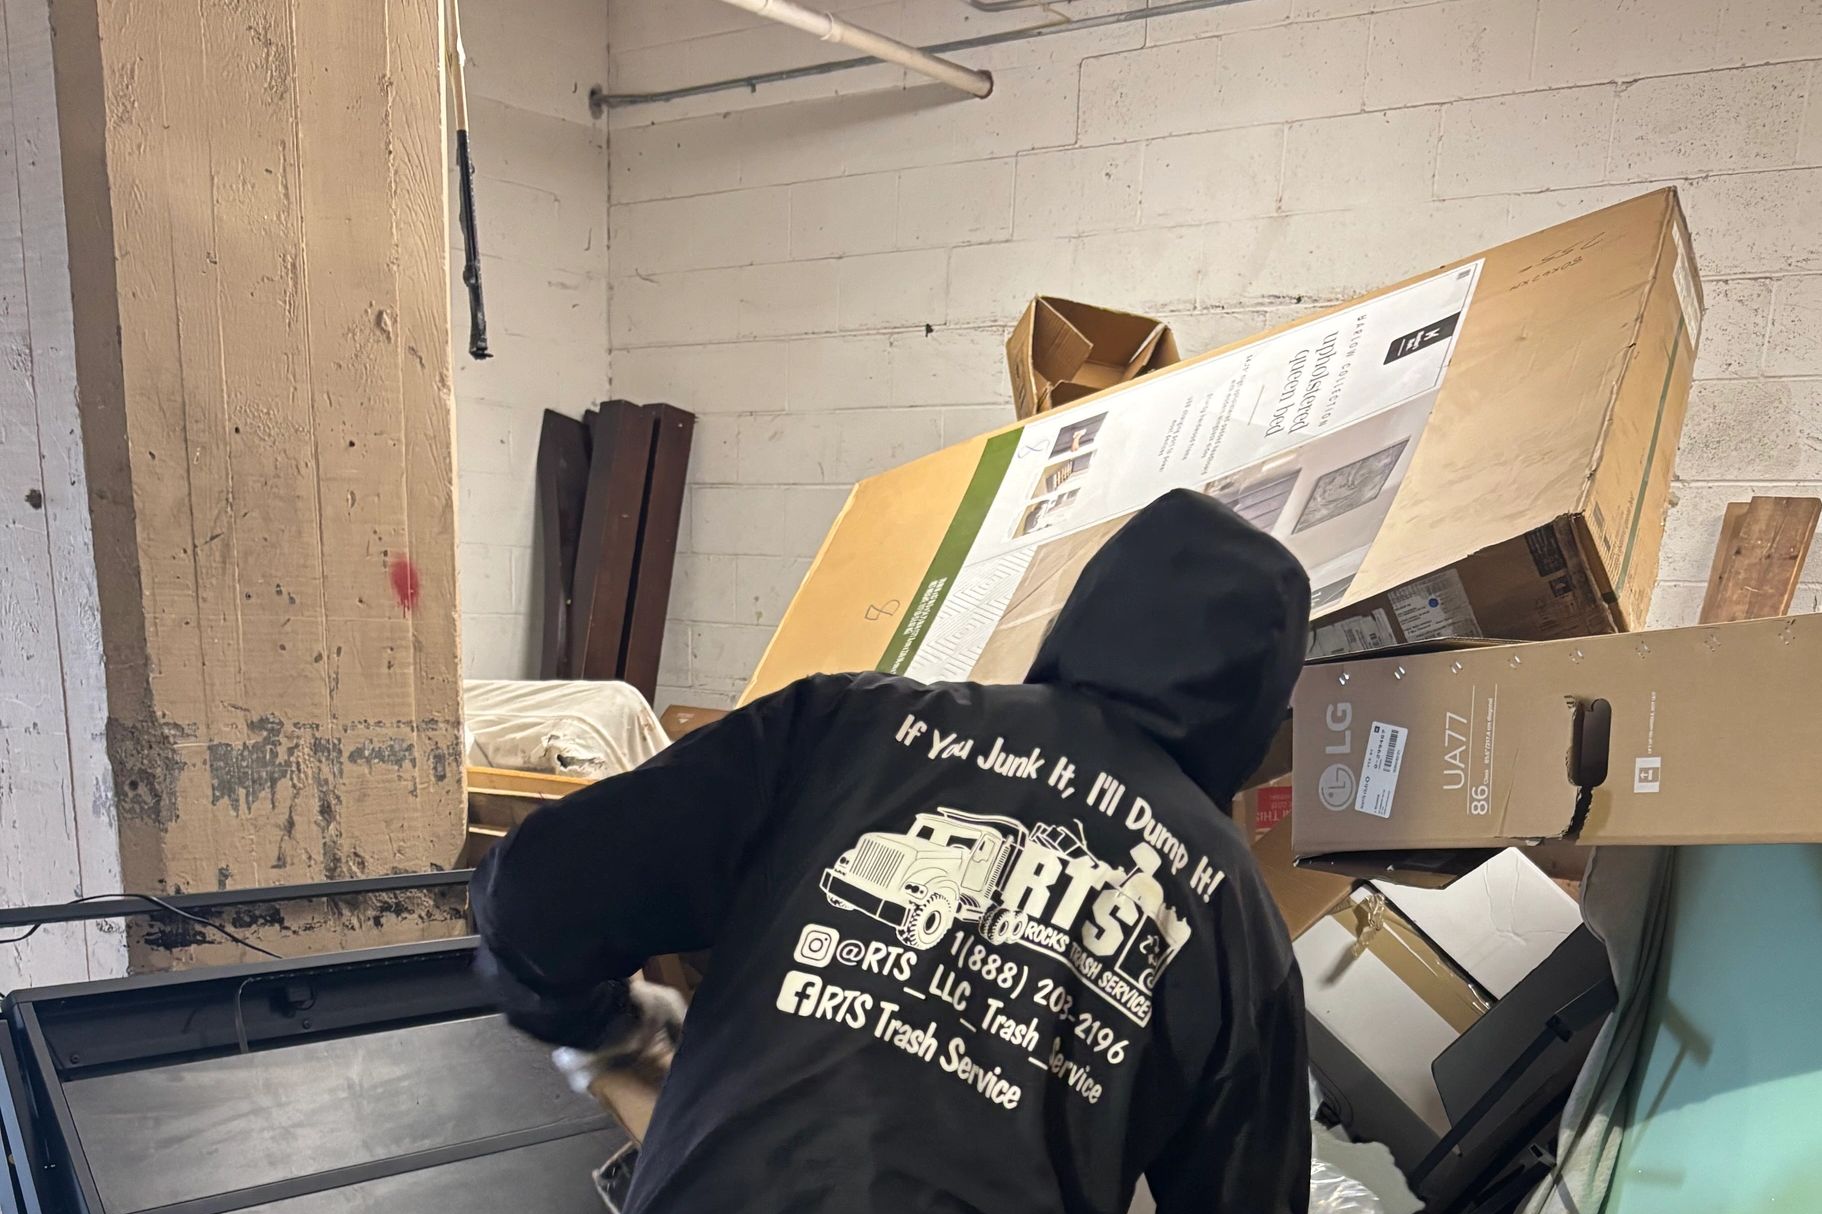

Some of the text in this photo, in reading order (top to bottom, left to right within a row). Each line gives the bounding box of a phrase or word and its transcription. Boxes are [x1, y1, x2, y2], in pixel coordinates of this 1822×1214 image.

[1264, 349, 1310, 438] queen bed
[1288, 331, 1338, 435] upholstered
[1318, 363, 1351, 427] COLLECTION
[1325, 702, 1352, 754] LG
[1443, 712, 1467, 789] UA77
[895, 713, 1225, 903] If You Junk It, I'll Dump It!
[1471, 785, 1489, 815] 86
[1001, 842, 1139, 956] RTS
[950, 931, 1129, 1064] 1(888) 203-2196
[1025, 921, 1151, 1018] ROCKS TRASH SERVICE
[815, 985, 1021, 1109] RTS Trash Service
